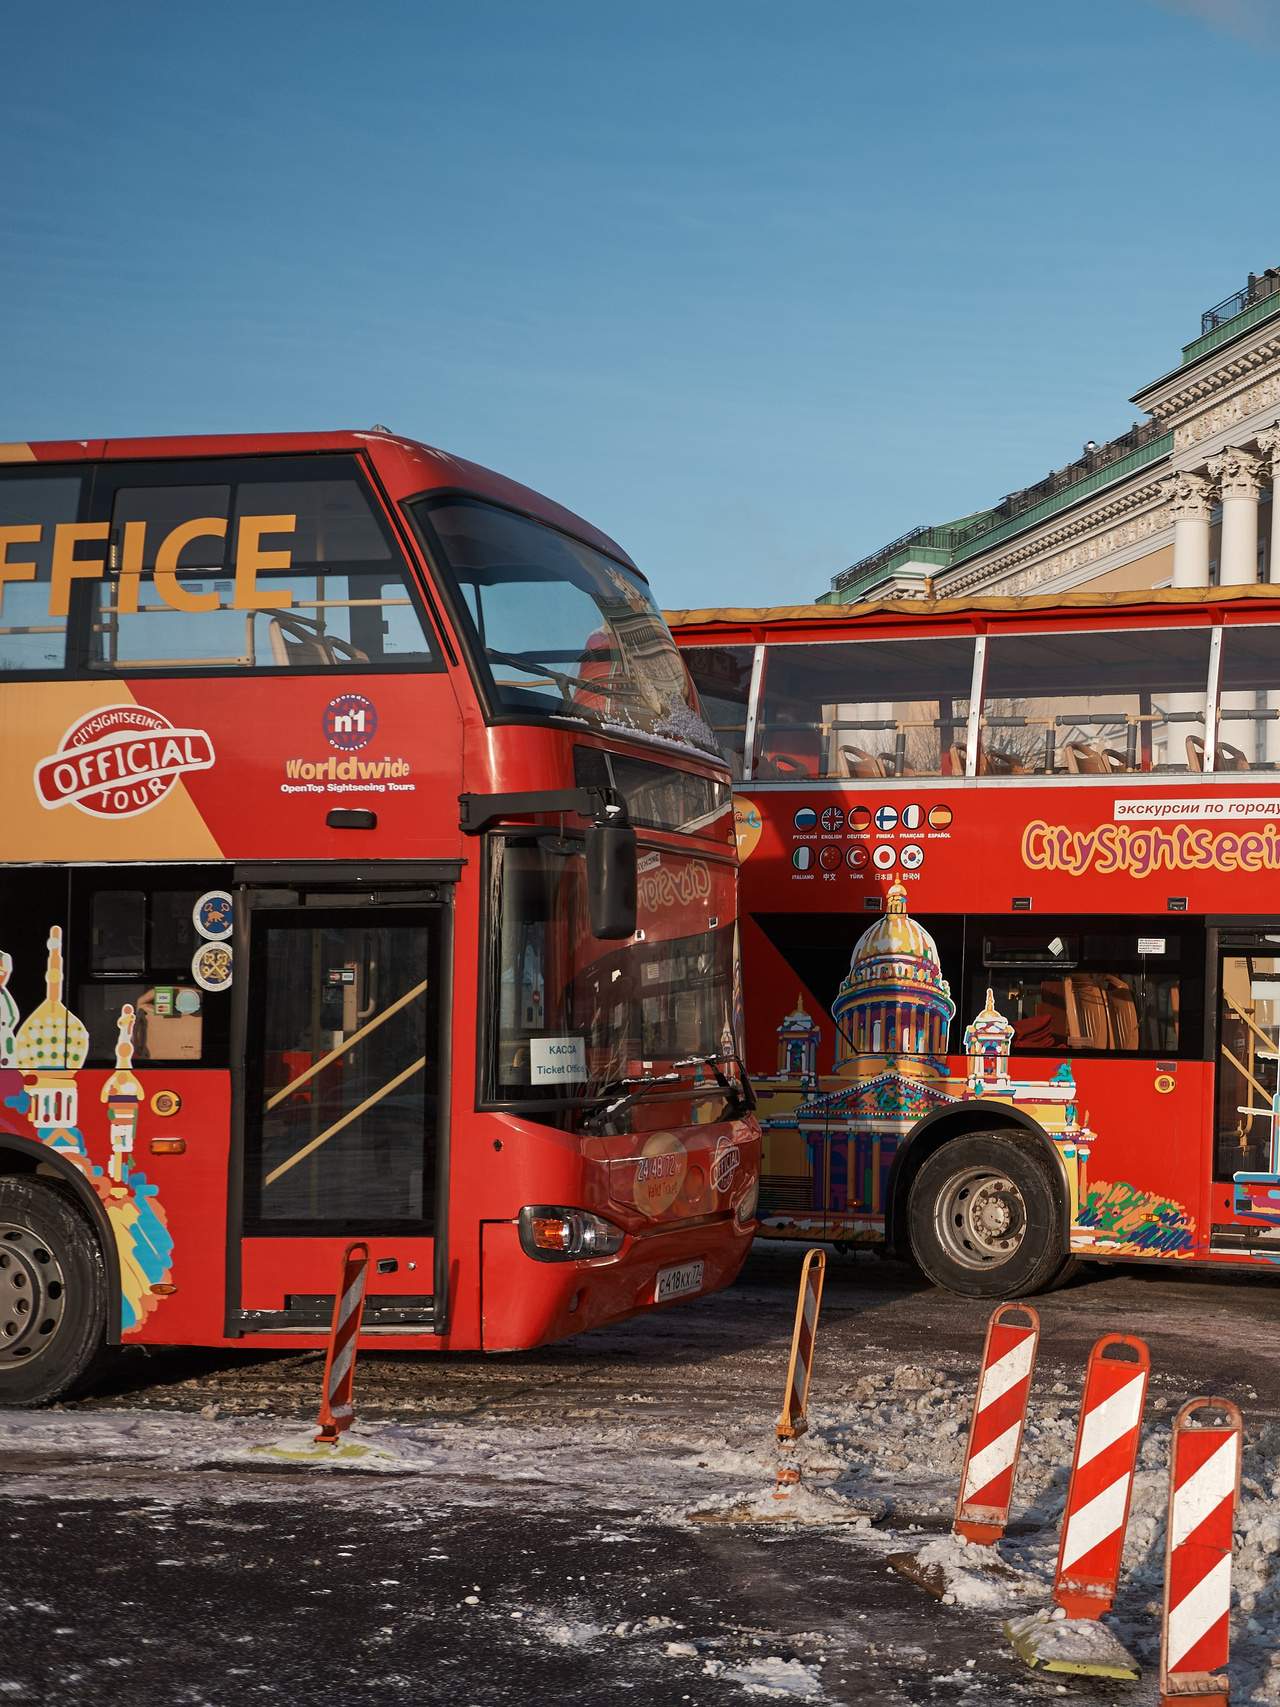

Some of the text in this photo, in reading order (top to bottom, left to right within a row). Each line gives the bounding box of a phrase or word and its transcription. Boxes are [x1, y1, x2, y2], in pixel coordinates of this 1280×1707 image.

[330, 694, 370, 706] Operador
[72, 712, 163, 748] CITYSIGHTSEEING
[329, 739, 368, 751] Operator
[53, 737, 203, 794] OFFICIAL
[286, 756, 410, 780] Worldwide
[100, 777, 167, 810] TOUR
[280, 782, 416, 794] OpenTop Sightseeing Tours
[1117, 802, 1199, 816] экскурсии
[1204, 803, 1222, 814] по
[792, 832, 818, 840] РУССКИЙ
[900, 832, 925, 840] FRANÇAIS
[823, 873, 836, 881] 中文
[874, 873, 893, 881] 日本語
[902, 872, 920, 881] 한국어
[549, 1045, 577, 1055] КАССА
[536, 1064, 584, 1075] Ticket Office
[714, 1151, 738, 1181] OFFICIAL
